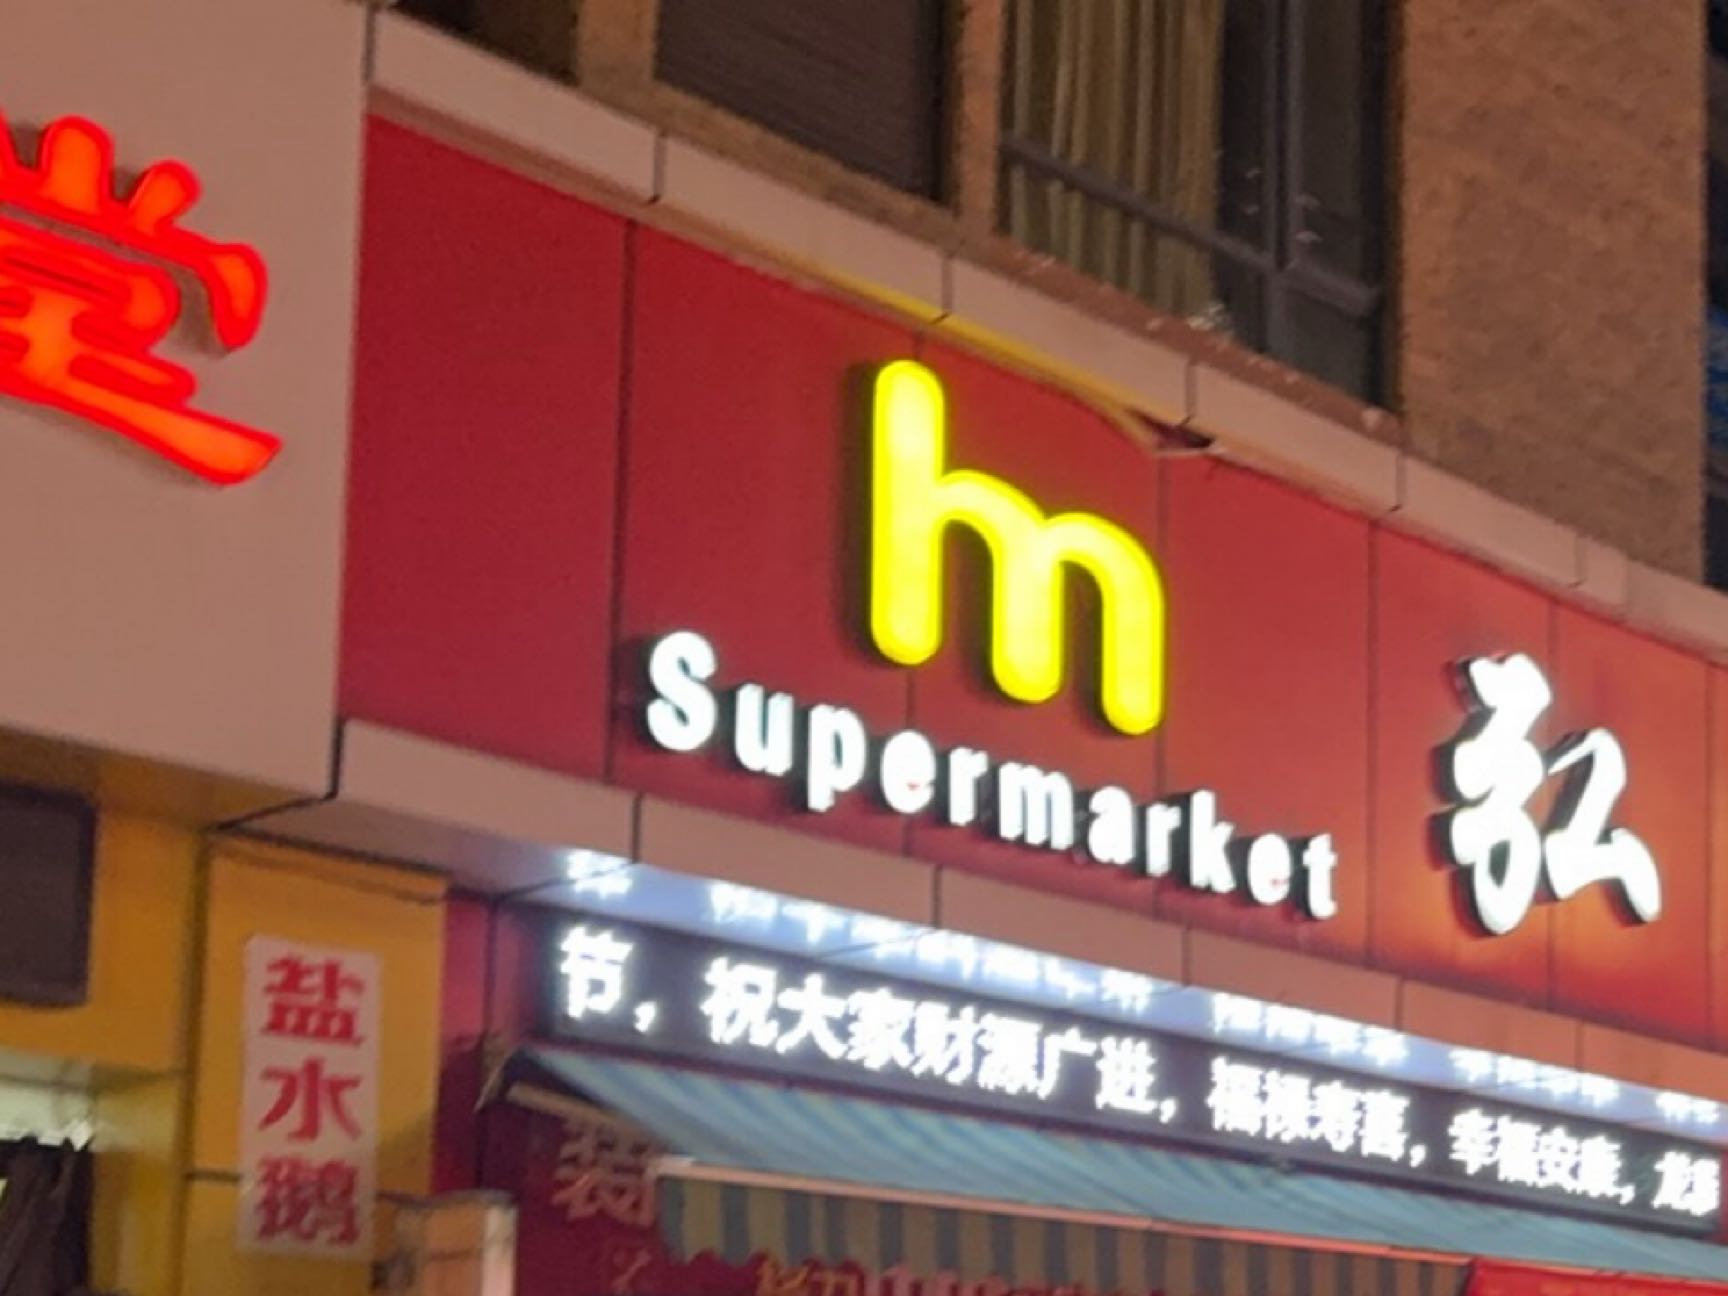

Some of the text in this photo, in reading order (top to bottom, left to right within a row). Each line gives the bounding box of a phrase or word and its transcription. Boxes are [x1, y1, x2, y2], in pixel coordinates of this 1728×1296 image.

[646, 631, 1338, 920] Supermarket
[257, 951, 367, 1248] 盐水鹅
